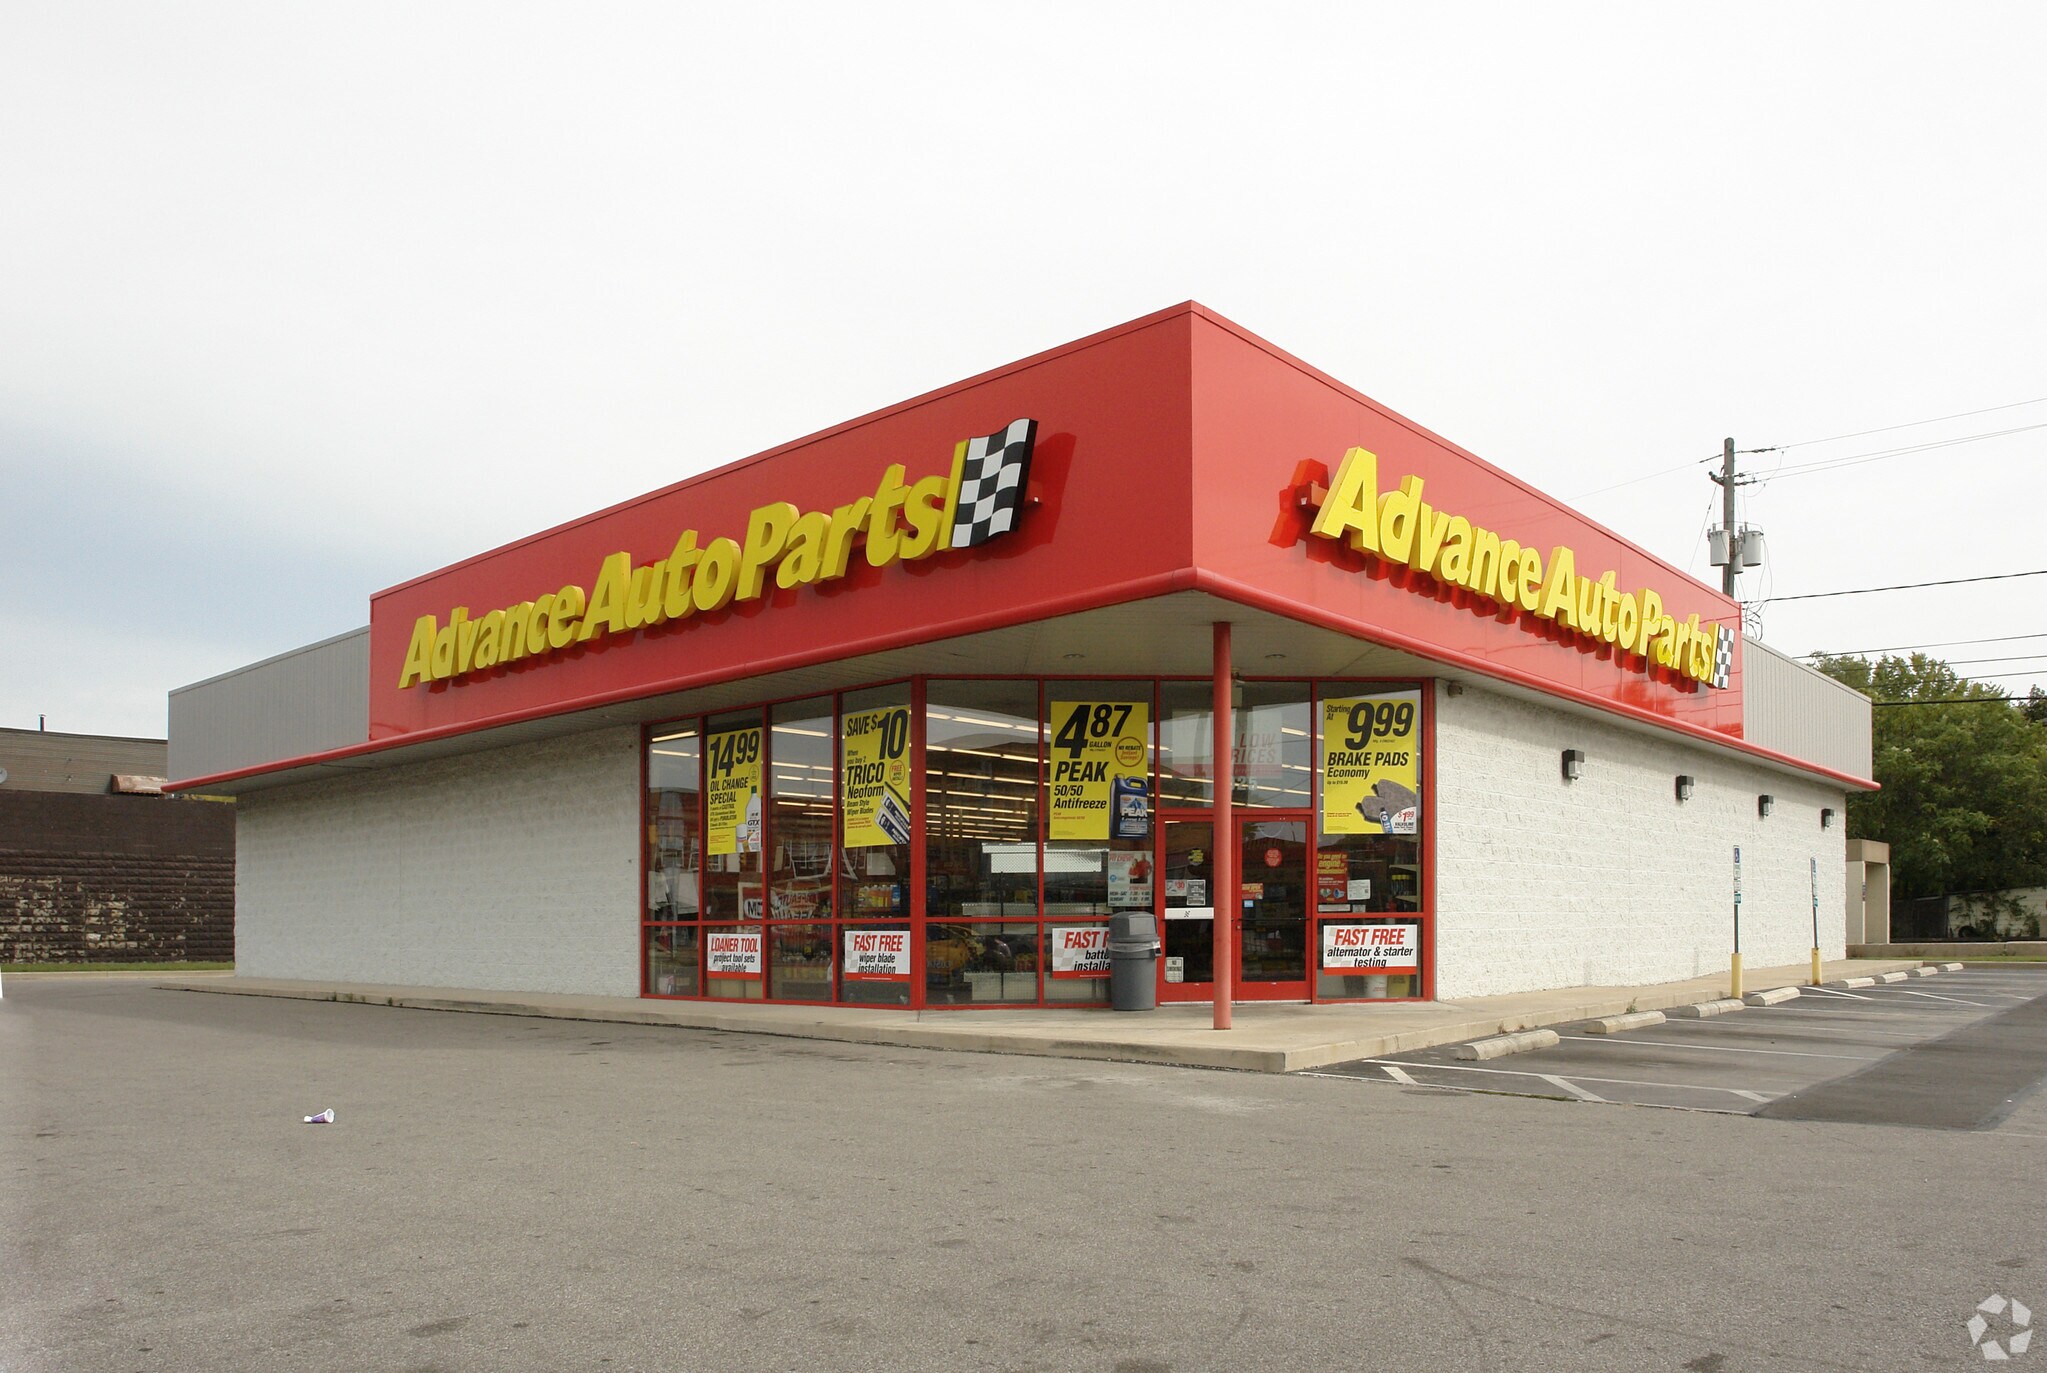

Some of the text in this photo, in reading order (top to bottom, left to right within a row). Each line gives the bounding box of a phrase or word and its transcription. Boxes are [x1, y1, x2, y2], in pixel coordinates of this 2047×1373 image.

[1326, 704, 1351, 714] Starting
[847, 715, 871, 737] SAVE
[1239, 733, 1276, 748] LOW
[1231, 748, 1276, 763] RICES
[1327, 752, 1409, 766] BRAKE PADS
[847, 762, 885, 786] TRICO
[1055, 761, 1109, 782] PEAK
[1327, 767, 1370, 779] Economy
[710, 776, 749, 793] OIL CHANGE
[1054, 785, 1084, 797] 50/50
[709, 790, 737, 805] SPECIAL
[847, 784, 884, 799] Neoform
[1054, 798, 1107, 809] Antifreeze
[1121, 807, 1147, 817] PEAK
[853, 934, 904, 952] FAST FREE
[1063, 930, 1101, 949] FAST
[1334, 928, 1406, 946] FAST FREE
[711, 937, 759, 952] LOANER TOOL
[1085, 947, 1110, 960] batte
[1327, 946, 1413, 957] alternator & starter
[713, 953, 756, 964] project tool sets
[859, 953, 896, 964] wiper blade
[1354, 957, 1387, 968] testing
[721, 963, 747, 972] available
[858, 963, 896, 974] installation
[1073, 961, 1111, 971] installa
